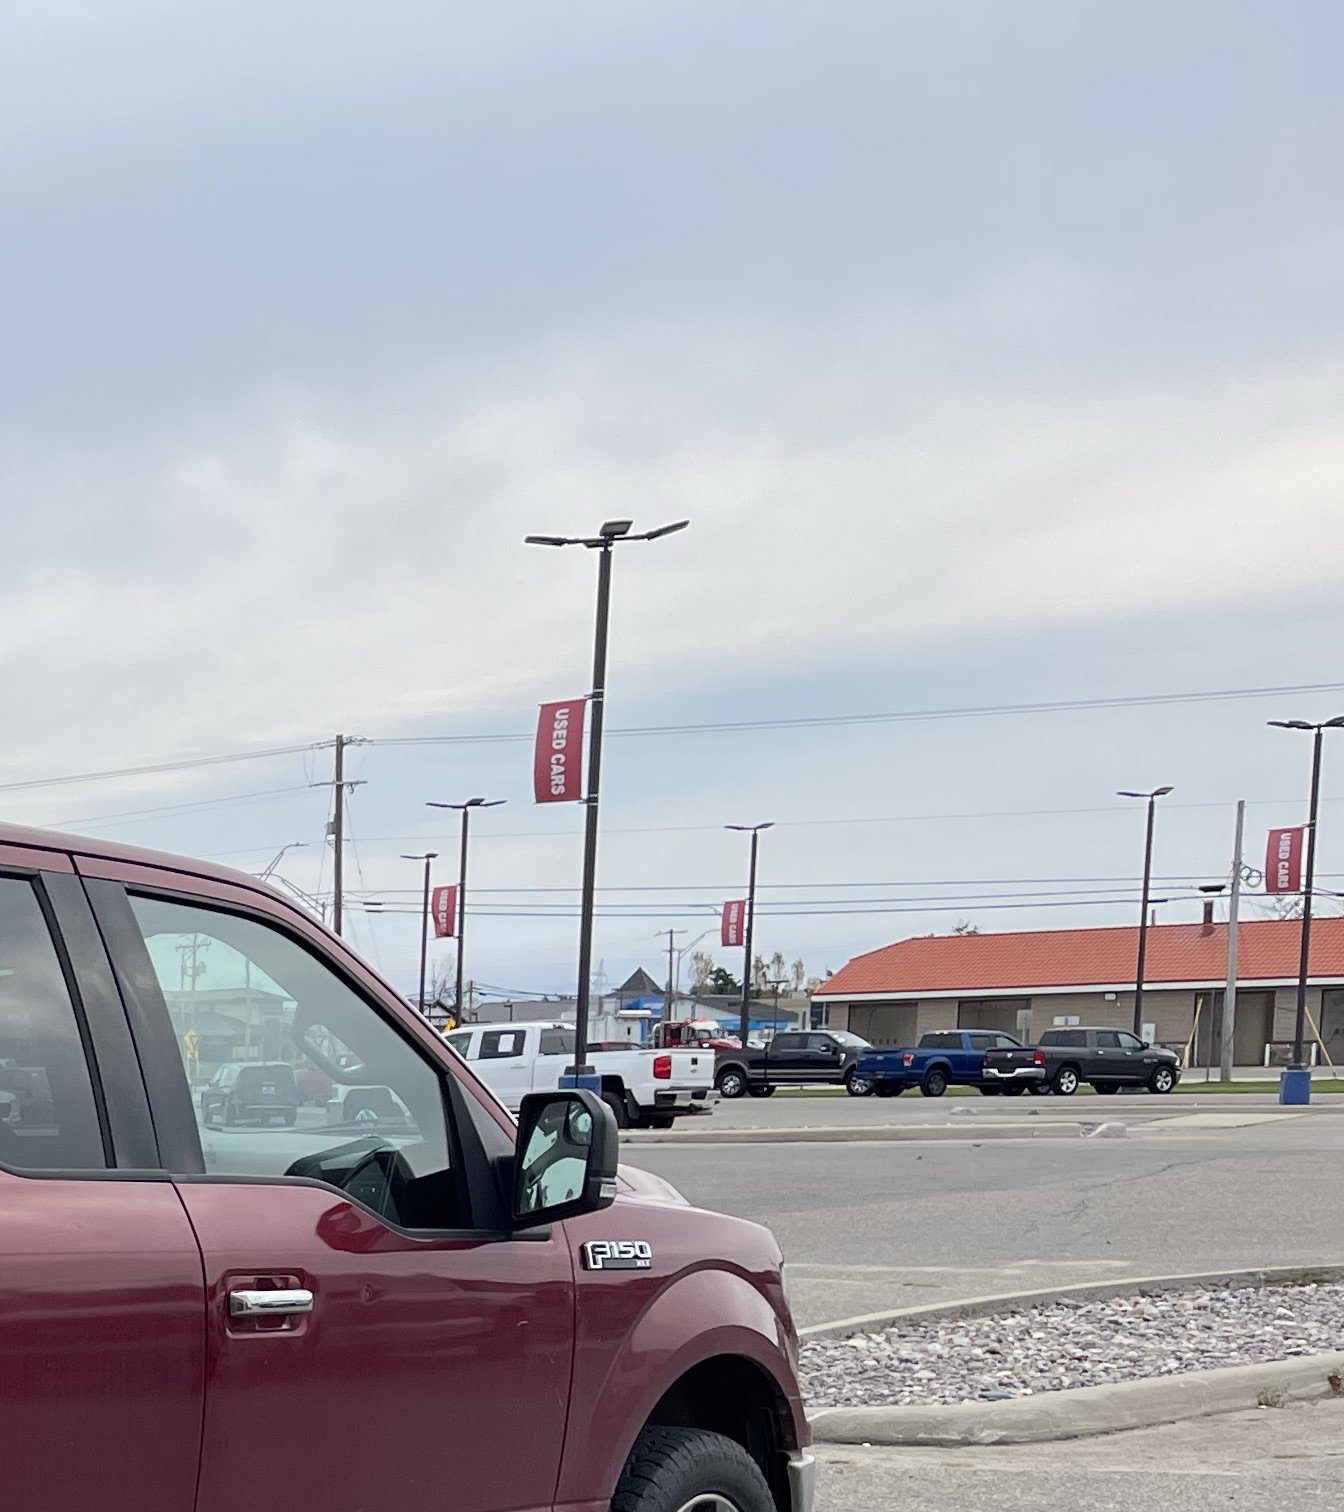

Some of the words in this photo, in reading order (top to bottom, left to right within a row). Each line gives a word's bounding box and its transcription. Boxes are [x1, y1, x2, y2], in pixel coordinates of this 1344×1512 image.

[552, 707, 570, 750] USED
[550, 753, 567, 796] CARS
[1277, 832, 1293, 860] USED
[1277, 861, 1290, 889] CARS
[438, 889, 450, 911] USED
[728, 903, 740, 924] USED
[728, 924, 738, 945] CARS
